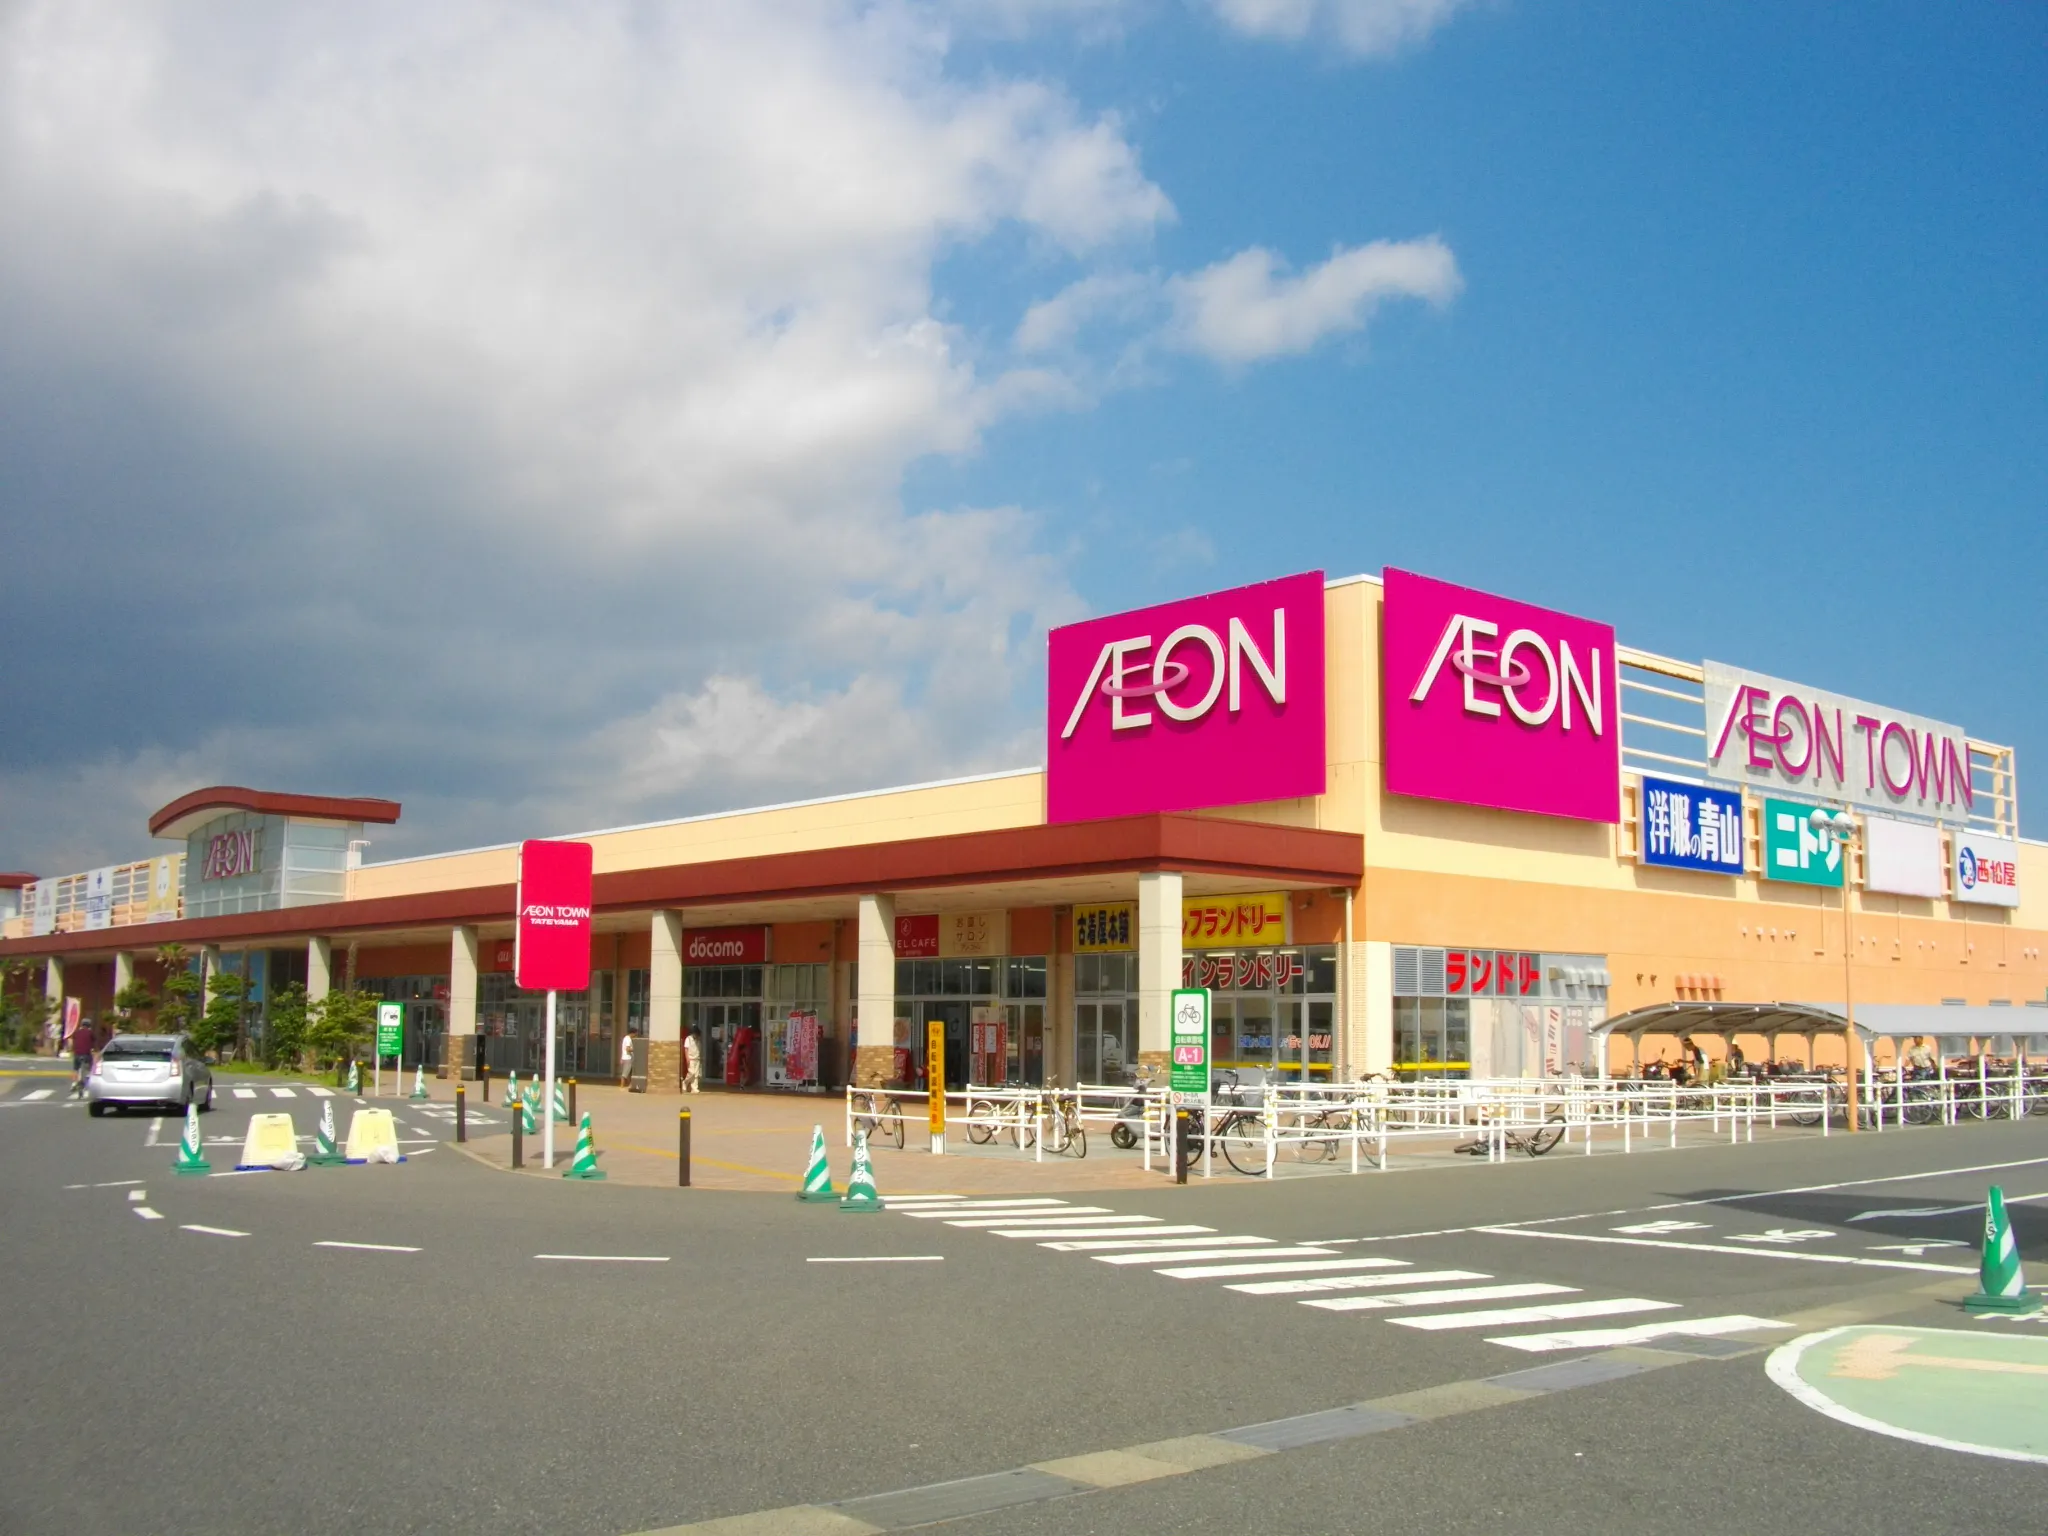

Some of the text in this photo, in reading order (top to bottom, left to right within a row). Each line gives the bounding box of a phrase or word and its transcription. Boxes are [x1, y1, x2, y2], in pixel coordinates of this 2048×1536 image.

[1856, 714, 1974, 809] TOWN
[1647, 789, 1740, 865] 洋服の青山
[1776, 812, 1842, 873] ニトリ
[1976, 857, 2016, 887] 西松屋
[530, 918, 579, 926] TATEYAMA
[556, 906, 590, 918] TOWN
[956, 916, 986, 928] お直し
[689, 935, 744, 958] docomo
[956, 932, 986, 942] サロン
[1446, 952, 1541, 995] ランドリー
[1178, 1047, 1199, 1062] A-1
